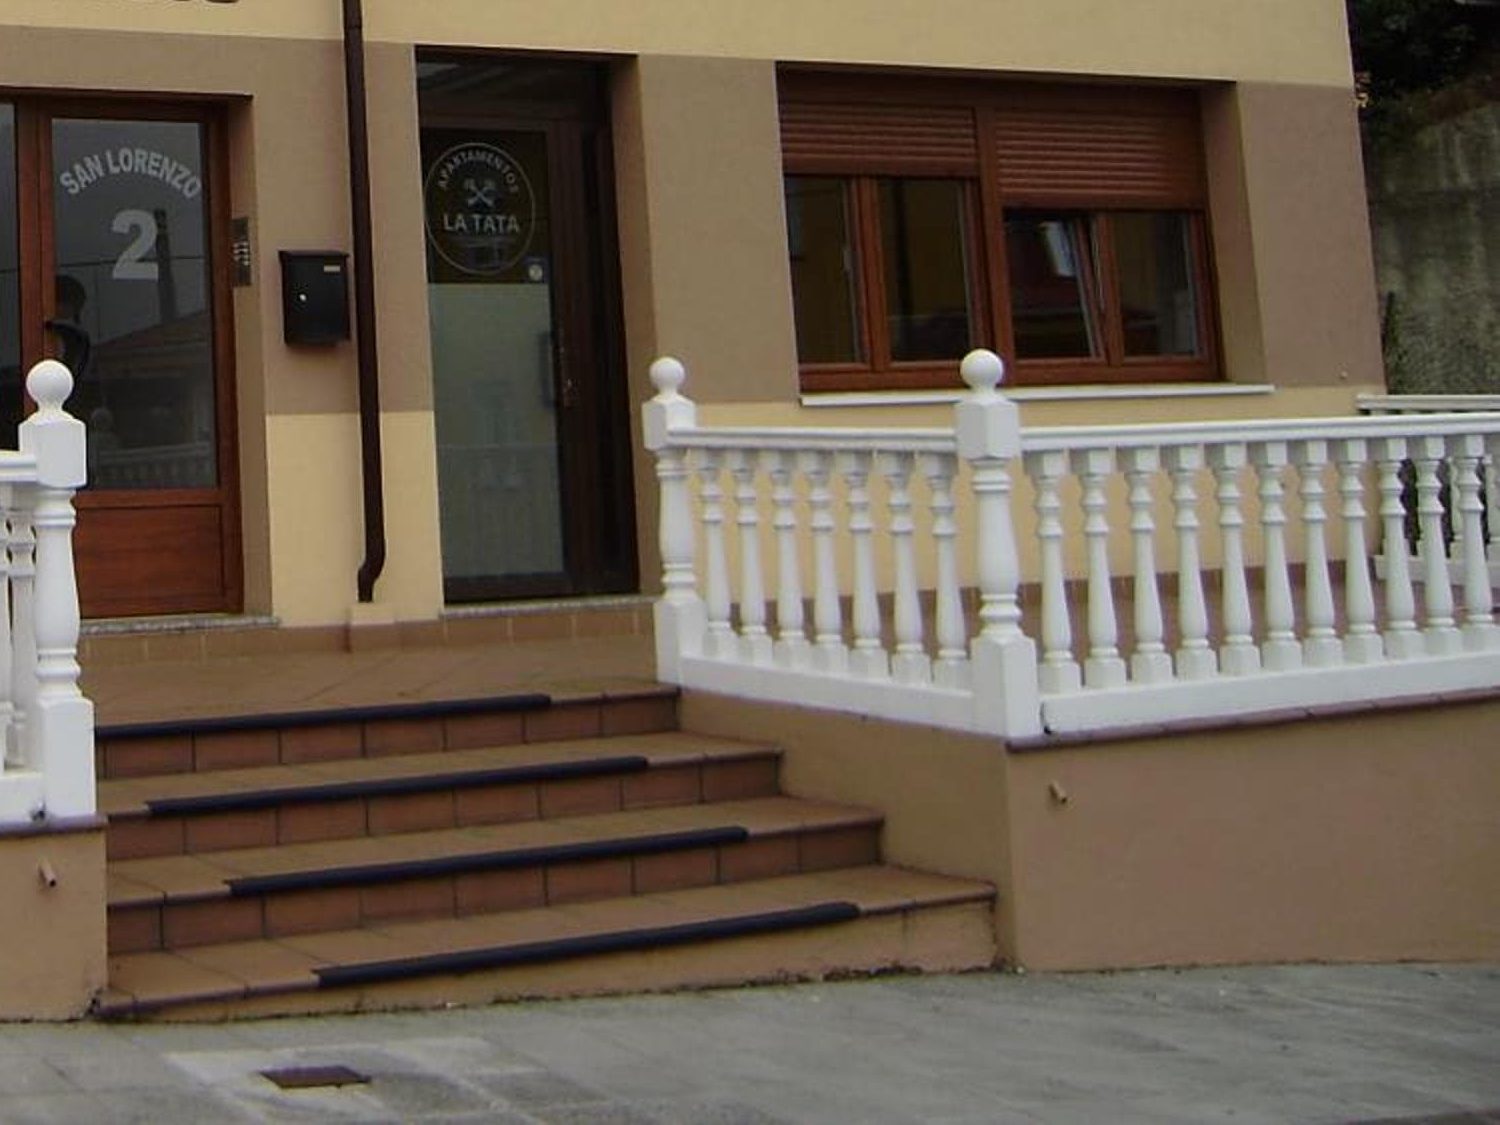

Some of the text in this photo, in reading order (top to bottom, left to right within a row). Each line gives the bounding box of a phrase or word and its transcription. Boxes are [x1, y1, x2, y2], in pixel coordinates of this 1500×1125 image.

[60, 147, 203, 200] SAN LORENZO
[112, 209, 159, 282] 2
[443, 213, 520, 233] LA TATA
